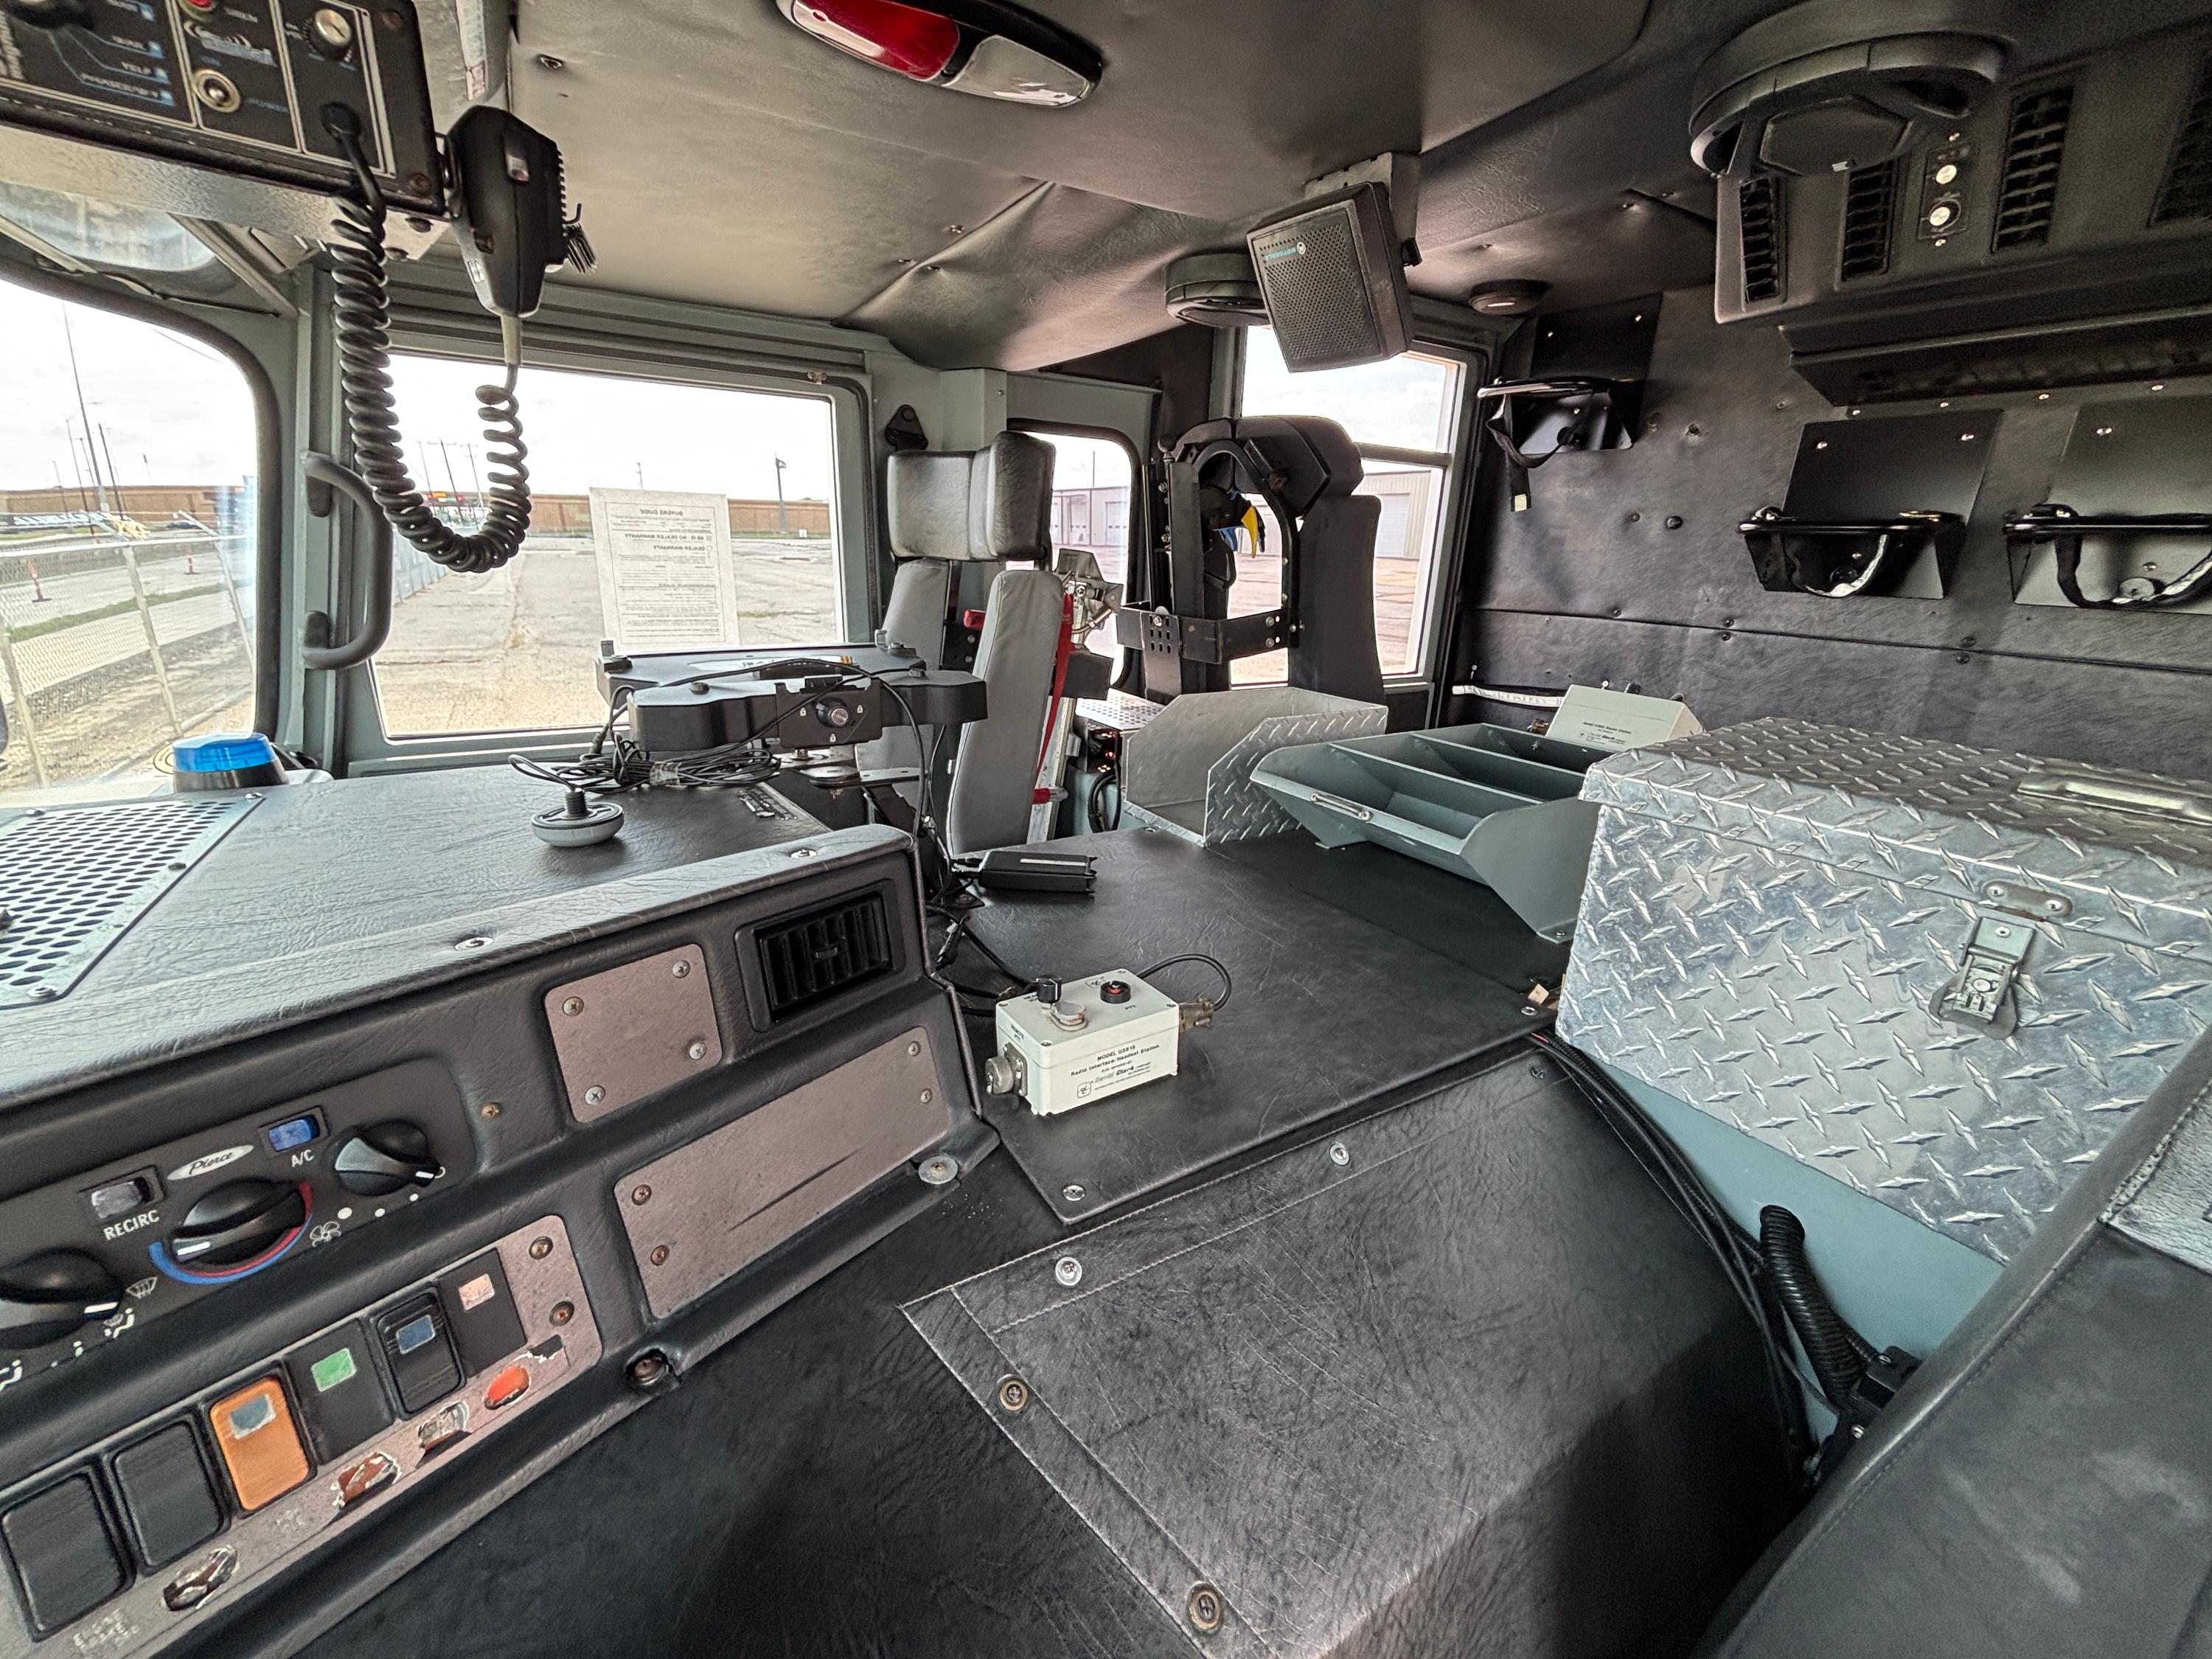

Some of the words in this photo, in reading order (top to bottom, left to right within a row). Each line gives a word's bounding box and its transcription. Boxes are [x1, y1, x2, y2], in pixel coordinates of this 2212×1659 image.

[1071, 1068, 1088, 1077] Radio
[1140, 1044, 1160, 1054] Station
[1097, 1051, 1116, 1061] MODEL
[1116, 1065, 1134, 1076] Clark
[189, 1151, 235, 1175] Pierce
[291, 1149, 316, 1168] A/C
[102, 1209, 160, 1241] RECIRC
